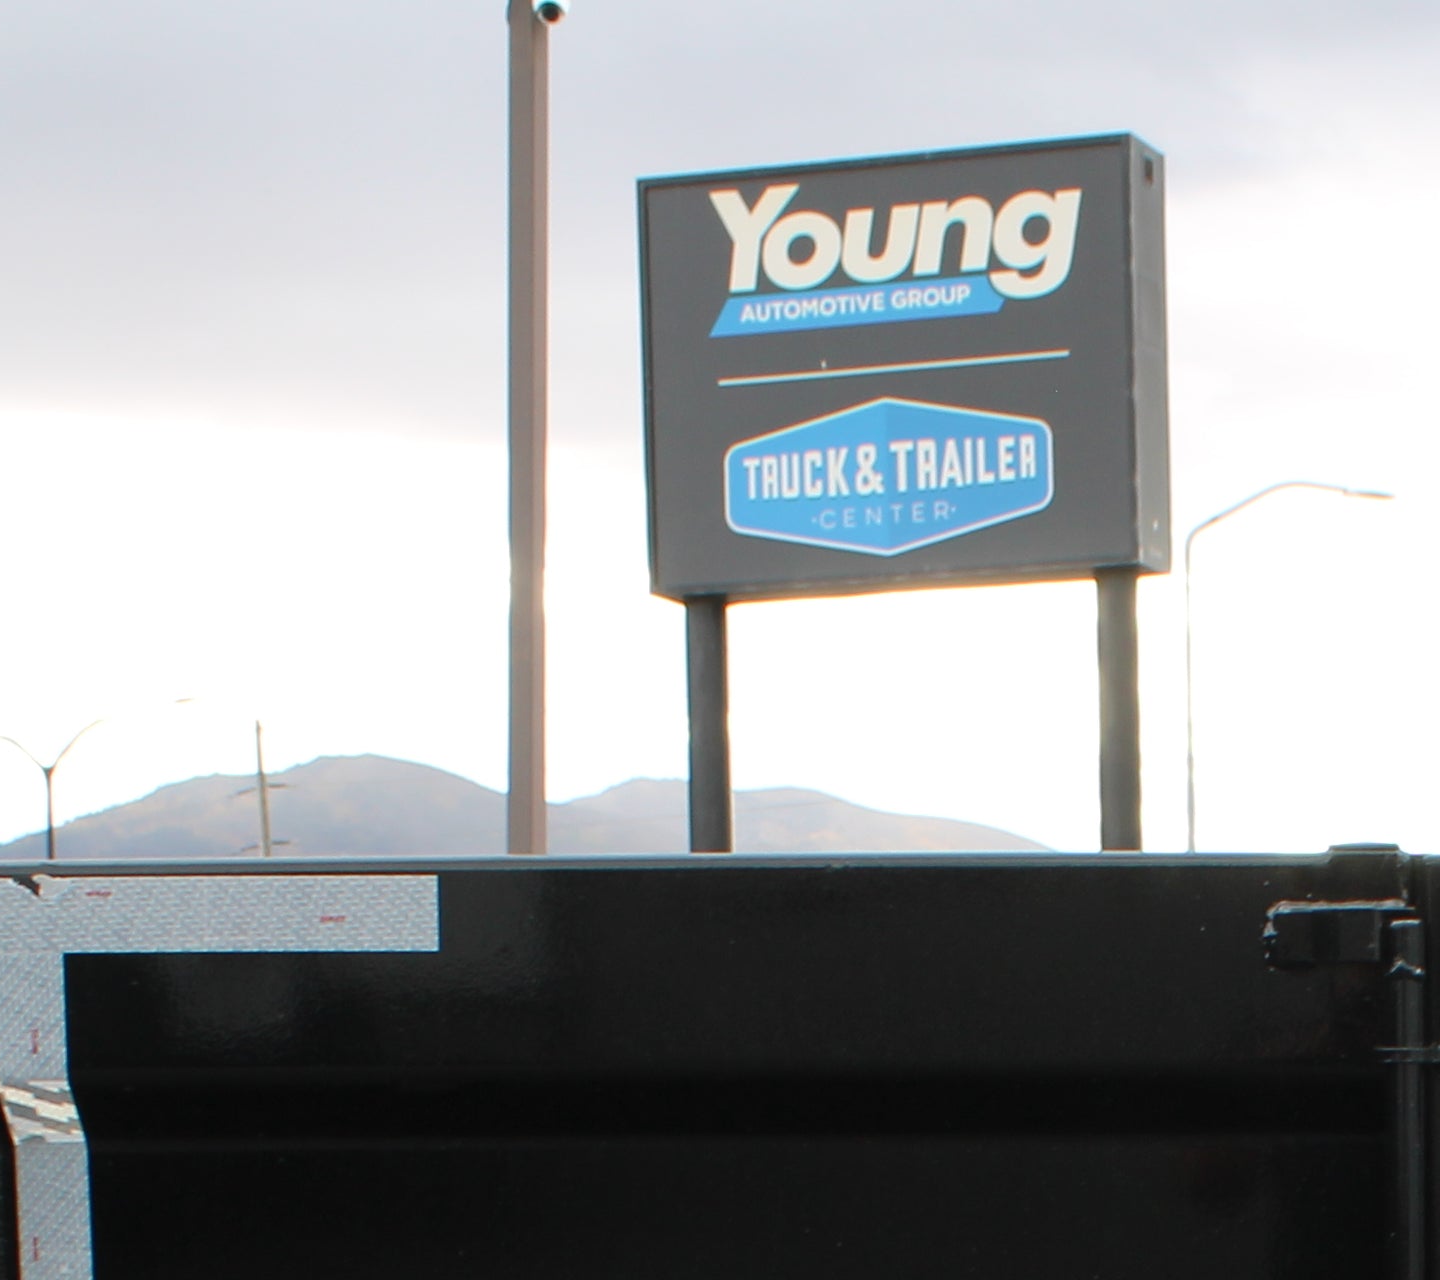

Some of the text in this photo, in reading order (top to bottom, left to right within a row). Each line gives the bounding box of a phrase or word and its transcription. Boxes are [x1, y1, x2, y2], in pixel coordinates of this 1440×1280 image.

[709, 183, 1082, 299] Young
[740, 284, 971, 323] AUTOMOTIVE GROUP
[742, 434, 1037, 500] TRUCK & TRAILER
[818, 500, 950, 529] CENTER
